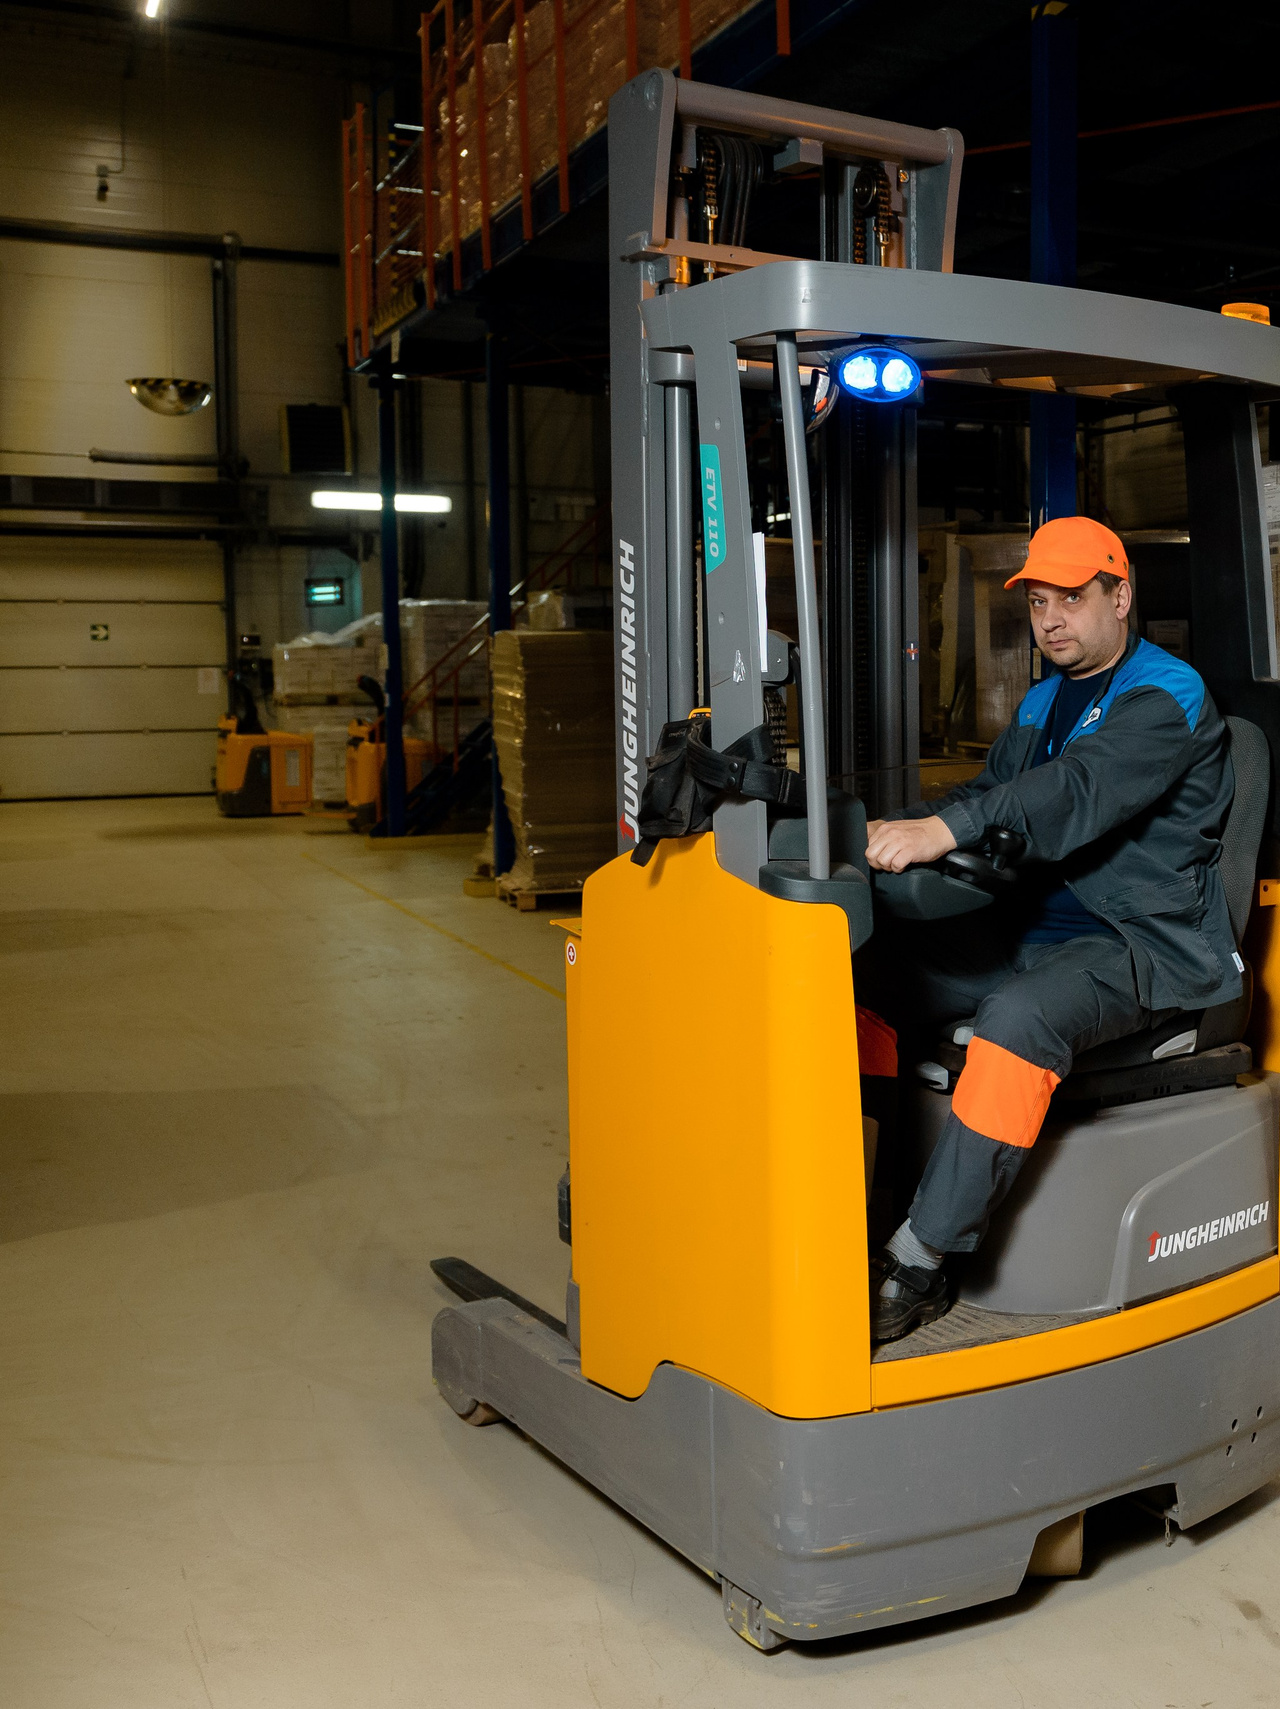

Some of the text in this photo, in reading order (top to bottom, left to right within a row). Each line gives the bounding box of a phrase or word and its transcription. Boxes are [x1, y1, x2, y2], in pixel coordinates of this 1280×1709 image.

[705, 467, 720, 558] ETV 110
[619, 539, 640, 843] JUNGHEINRICH
[1148, 1201, 1269, 1262] JUNGHEINRICH
